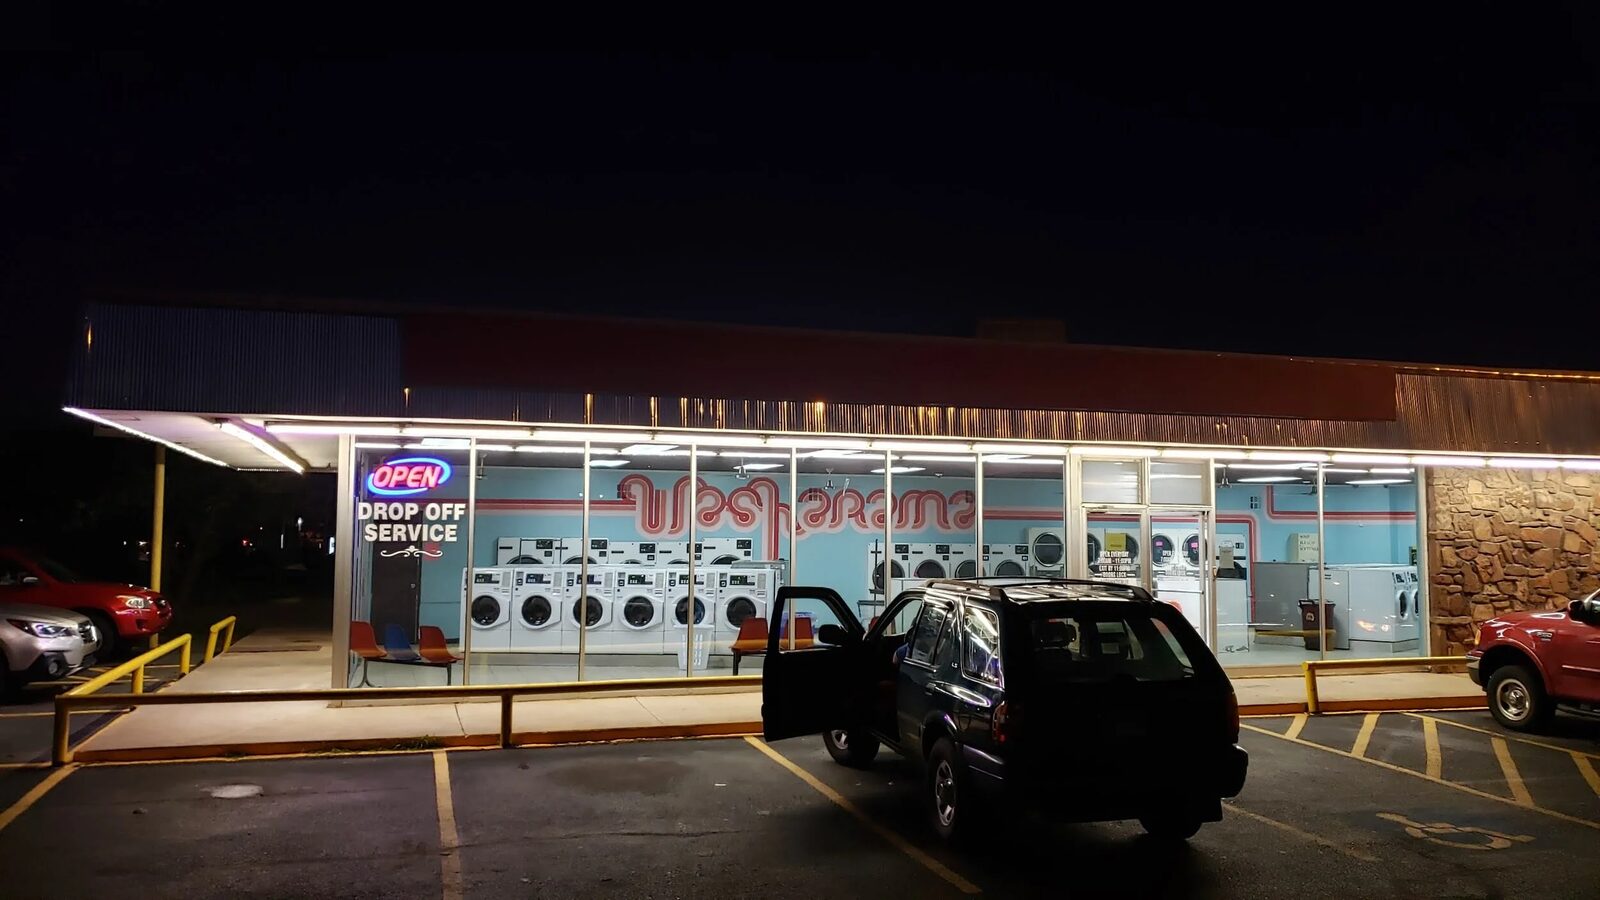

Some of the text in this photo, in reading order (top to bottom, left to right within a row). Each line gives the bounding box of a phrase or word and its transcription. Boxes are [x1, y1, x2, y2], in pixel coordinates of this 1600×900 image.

[373, 466, 442, 488] OPEN
[358, 502, 466, 520] DROP OFF
[364, 524, 458, 541] SERVICE
